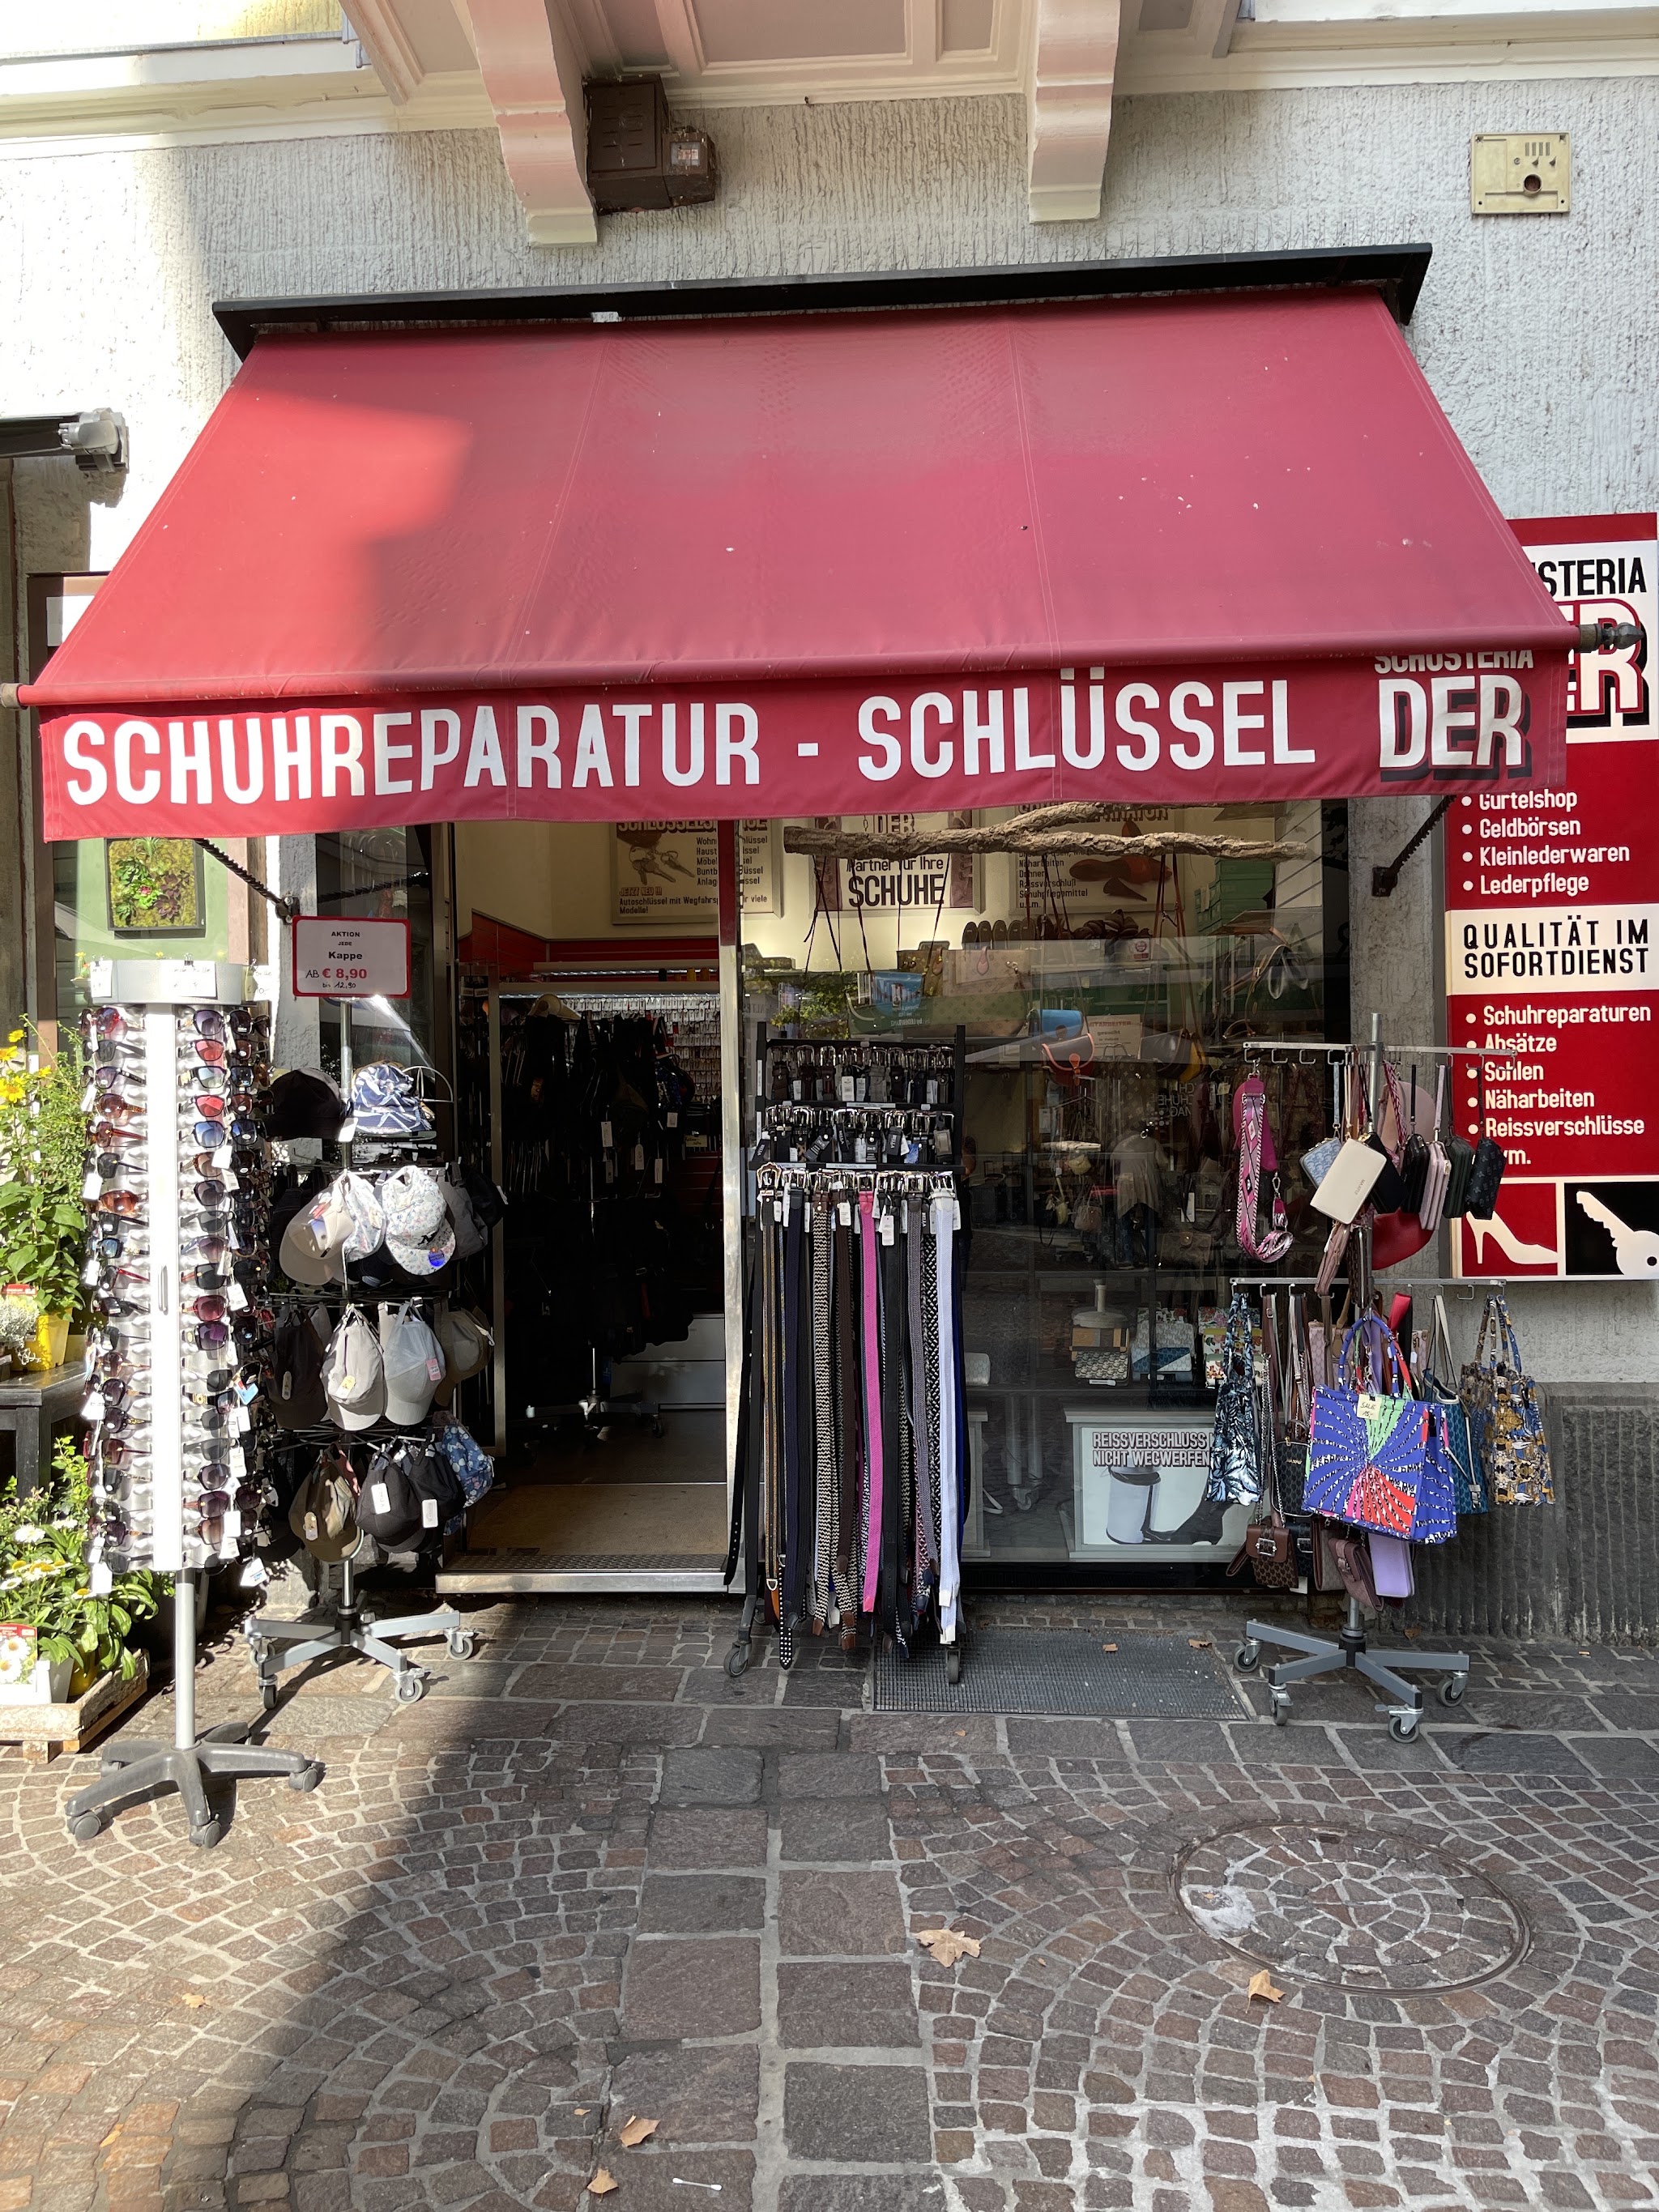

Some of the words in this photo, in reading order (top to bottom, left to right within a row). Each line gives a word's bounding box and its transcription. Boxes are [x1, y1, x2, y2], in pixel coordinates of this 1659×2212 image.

[63, 701, 760, 806] SCHUHREPARATUR
[798, 743, 818, 757] -
[858, 666, 1316, 782] SCHLÜSSEL
[1379, 674, 1532, 782] DER
[1480, 816, 1580, 839] Geldbörsen
[919, 855, 945, 871] Ihre
[1480, 845, 1631, 867] Kleinlederwaren
[640, 886, 654, 896] NEU
[848, 873, 945, 907] SCHUHE
[1480, 872, 1590, 898] Lederpflege
[619, 897, 668, 906] Autoschlüssel
[669, 897, 681, 905] mit
[750, 894, 768, 903] viele
[619, 906, 649, 914] Modelle!
[1464, 914, 1599, 950] QUALITÄT
[1617, 918, 1648, 945] IM
[328, 951, 364, 961] Kappe
[1465, 948, 1649, 979] SOFORTDIENST
[305, 969, 320, 978] AB
[322, 968, 331, 978] €
[335, 968, 368, 981] 8,90
[1483, 1005, 1651, 1029] Schuhreparaturen
[1485, 1033, 1557, 1053] Absätze
[1484, 1061, 1544, 1081] Sohlen
[1485, 1088, 1595, 1110] Näharbeiten
[1485, 1115, 1645, 1138] Reissverschlüsse
[1360, 1402, 1376, 1410] SALE
[1093, 1431, 1207, 1449] REISSVERSCHLUSS
[1093, 1450, 1129, 1467] NICHT
[1132, 1450, 1210, 1467] WEGWERFEN
